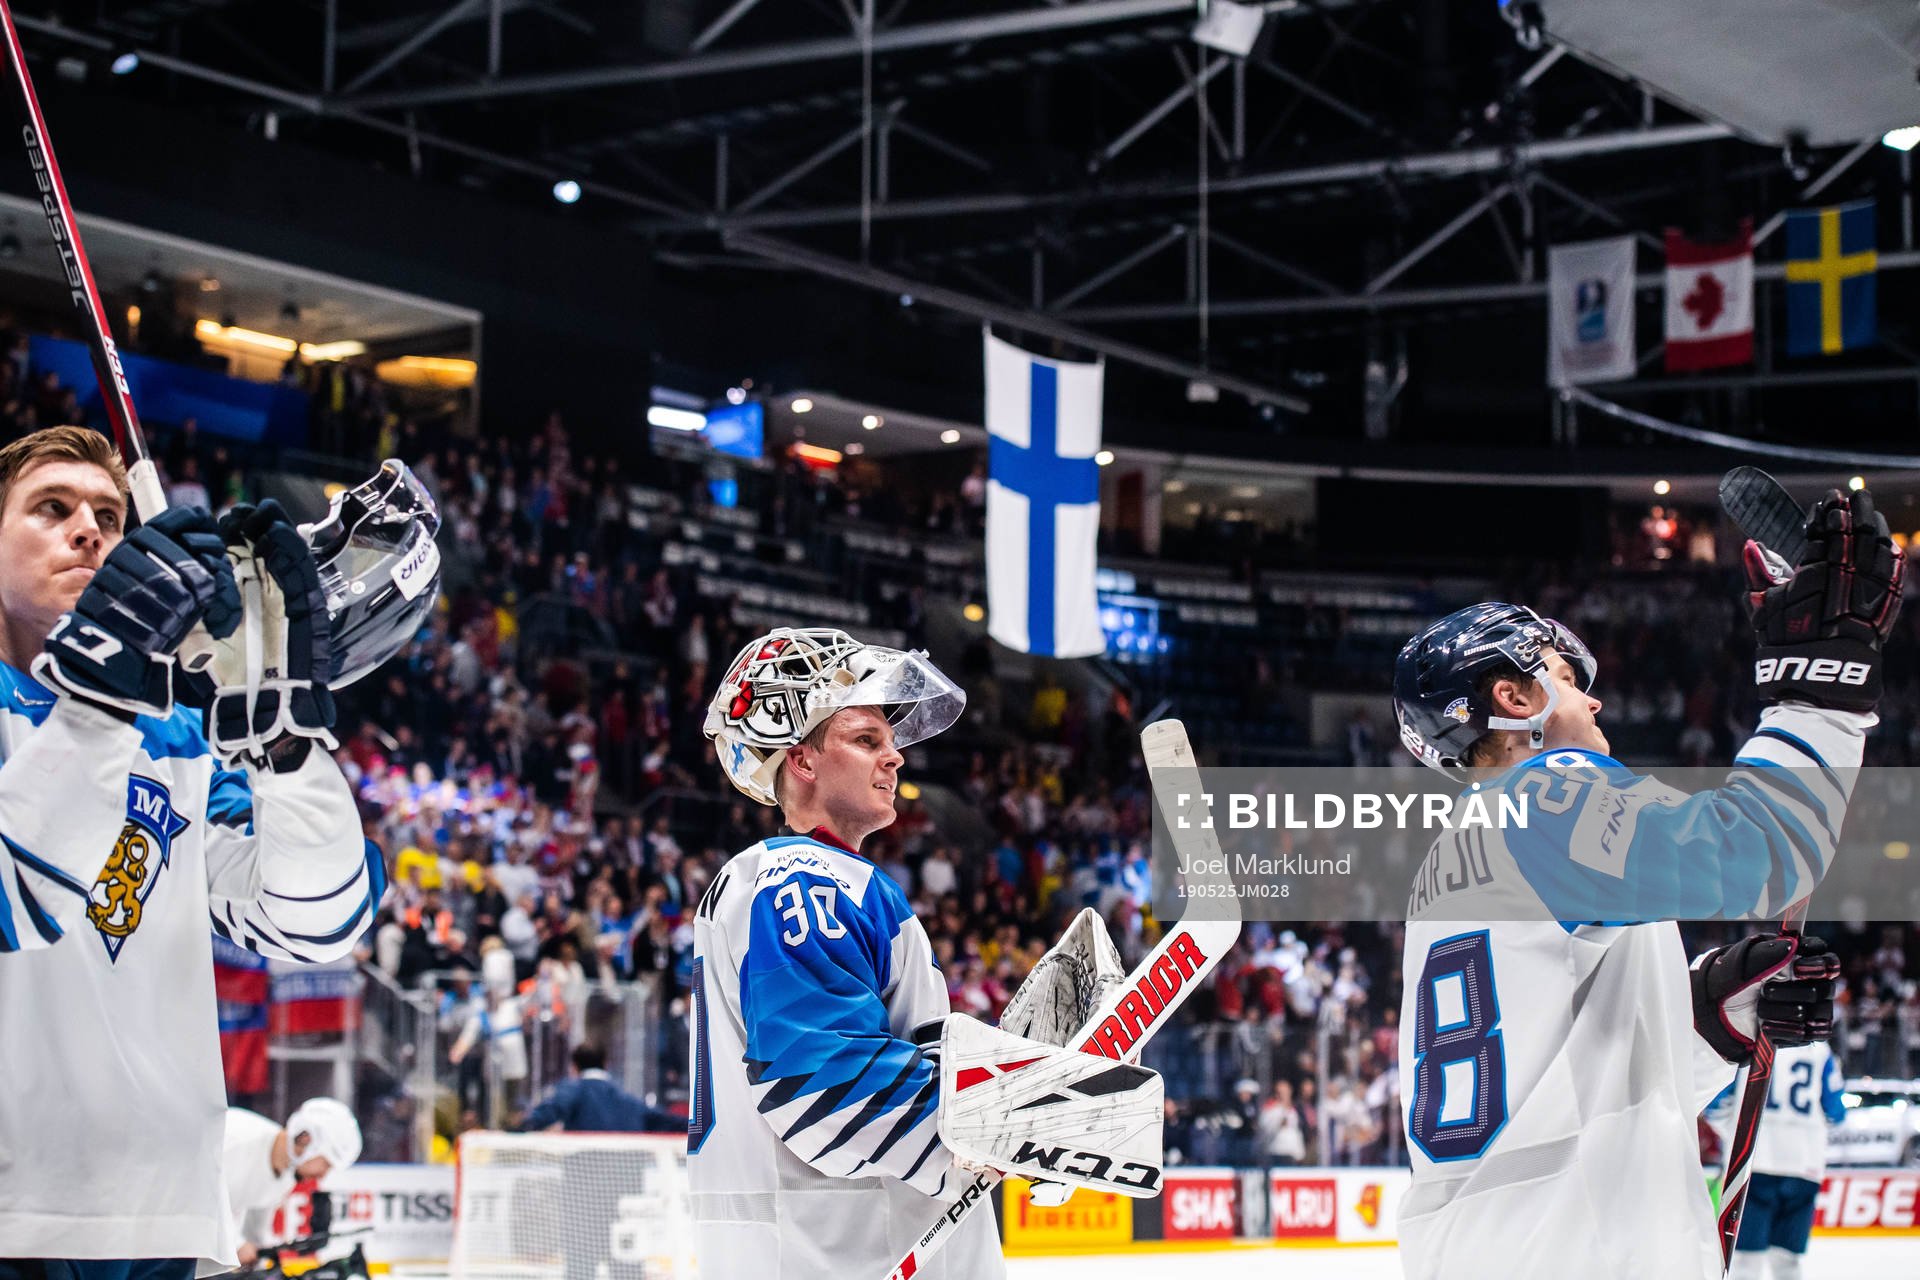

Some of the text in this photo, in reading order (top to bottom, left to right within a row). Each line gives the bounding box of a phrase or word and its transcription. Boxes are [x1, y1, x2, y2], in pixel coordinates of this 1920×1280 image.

[22, 124, 91, 315] JETSPEED
[104, 335, 130, 395] CCM
[1514, 751, 1609, 815] 28
[700, 872, 731, 921] N
[773, 881, 848, 947] 30
[1010, 1140, 1161, 1190] CCM
[920, 1216, 947, 1247] CUSTOM
